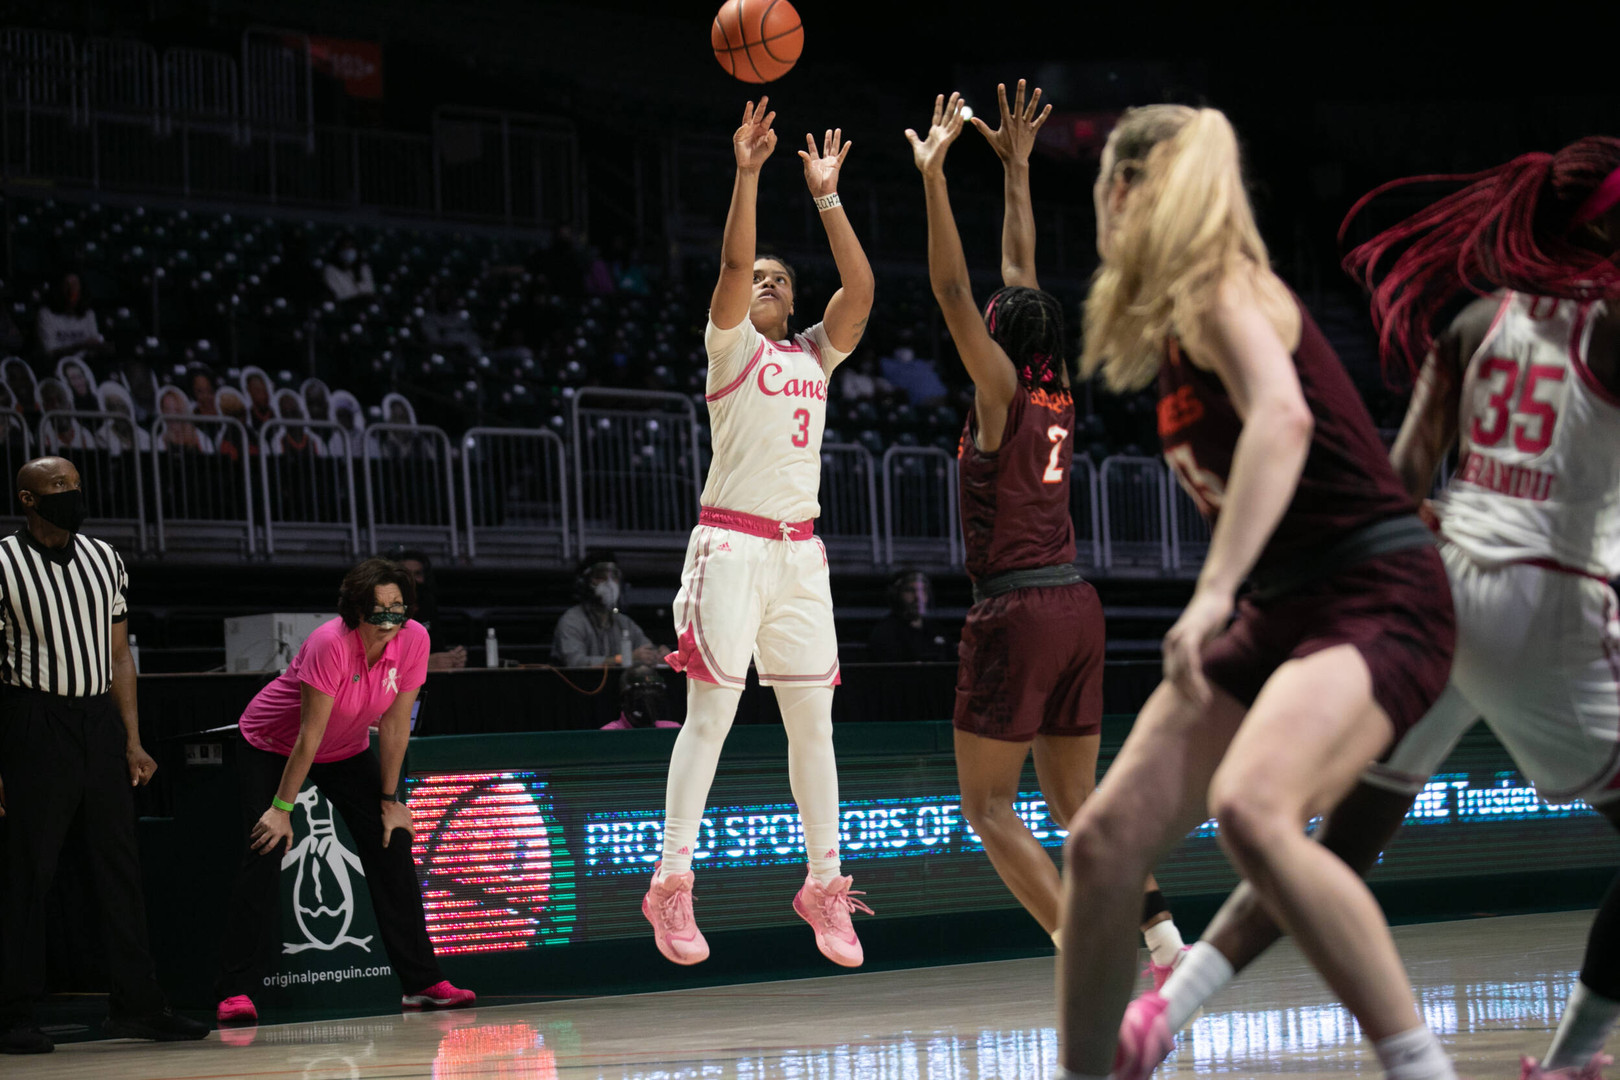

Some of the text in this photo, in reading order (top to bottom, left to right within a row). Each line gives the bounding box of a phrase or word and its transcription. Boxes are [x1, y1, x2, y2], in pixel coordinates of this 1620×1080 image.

[791, 407, 811, 449] 3
[1469, 357, 1566, 454] 35
[1042, 424, 1069, 483] 2
[1460, 451, 1556, 501] BANDU
[585, 819, 717, 866] PROD
[725, 808, 908, 858] SPOORS
[917, 804, 961, 845] OF
[1451, 778, 1540, 815] Trusted
[263, 965, 392, 988] originalpenguin.com
